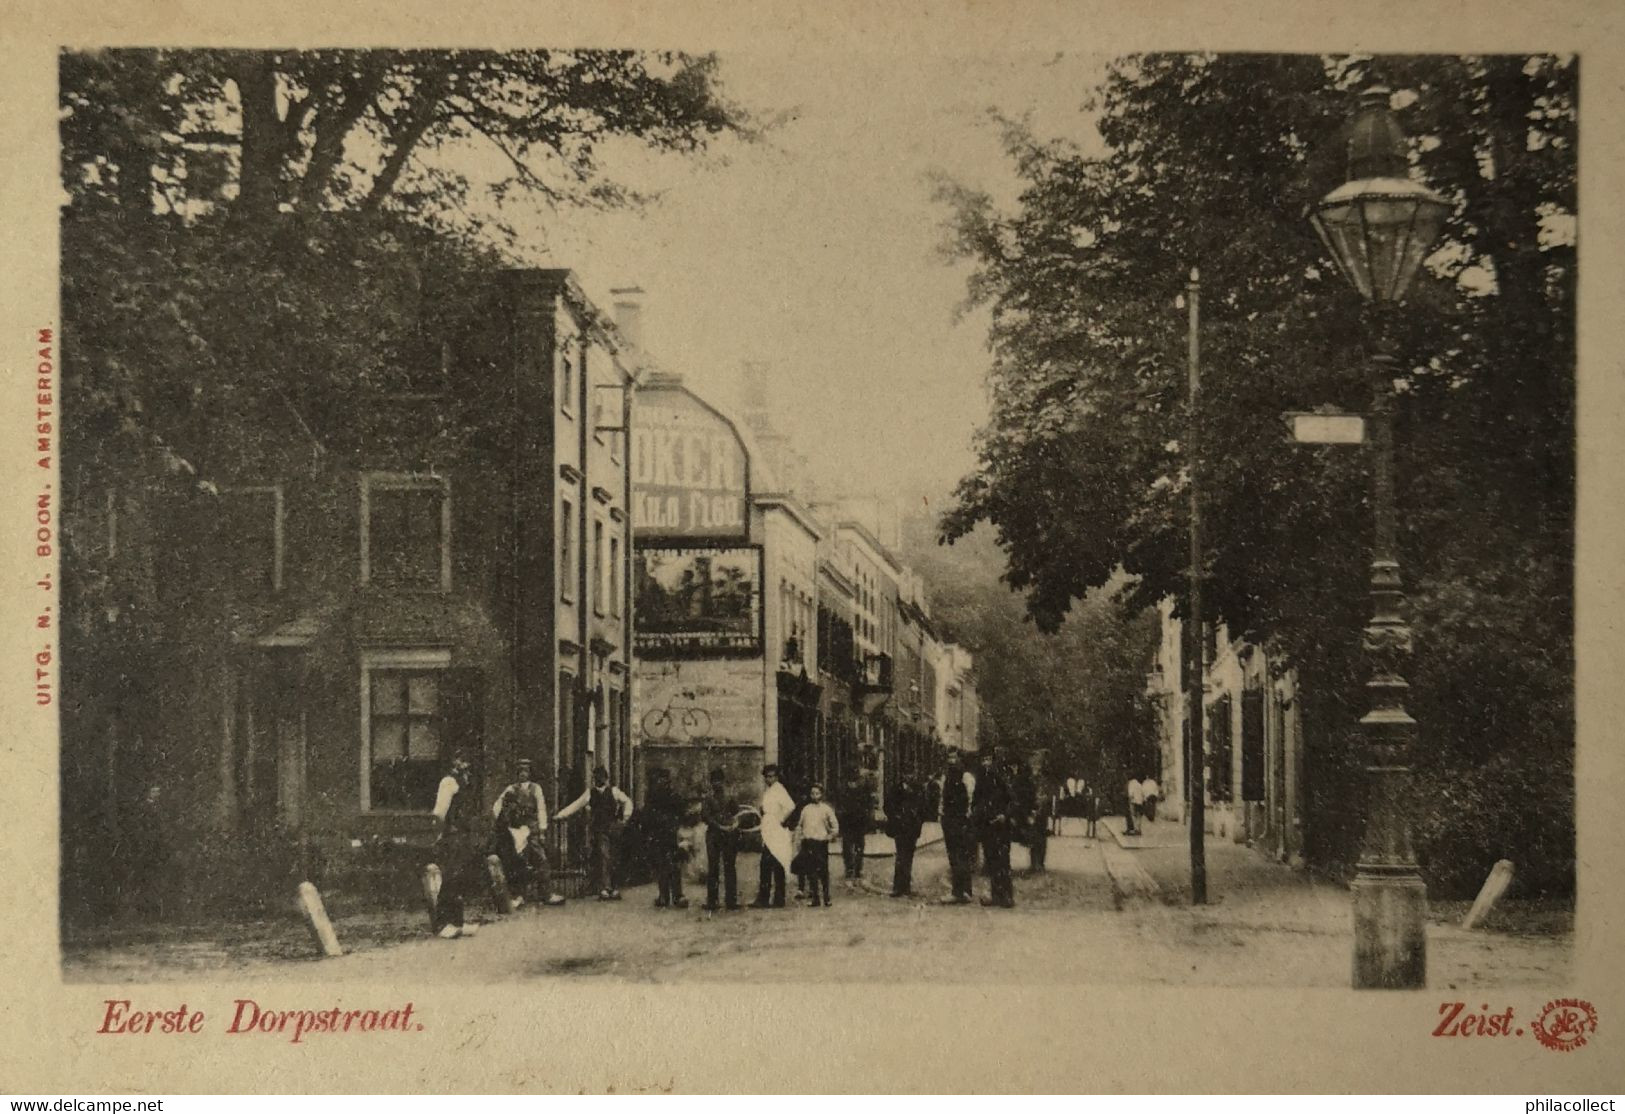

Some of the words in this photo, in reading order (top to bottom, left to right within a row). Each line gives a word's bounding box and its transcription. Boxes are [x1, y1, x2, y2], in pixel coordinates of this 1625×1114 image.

[36, 484, 52, 557] BOON.
[36, 573, 52, 591] J.
[37, 606, 52, 629] N.
[36, 643, 53, 706] UITG.
[96, 999, 205, 1036] Eerste
[227, 998, 425, 1045] Dorpstraat.
[1432, 1002, 1525, 1038] Zeist.
